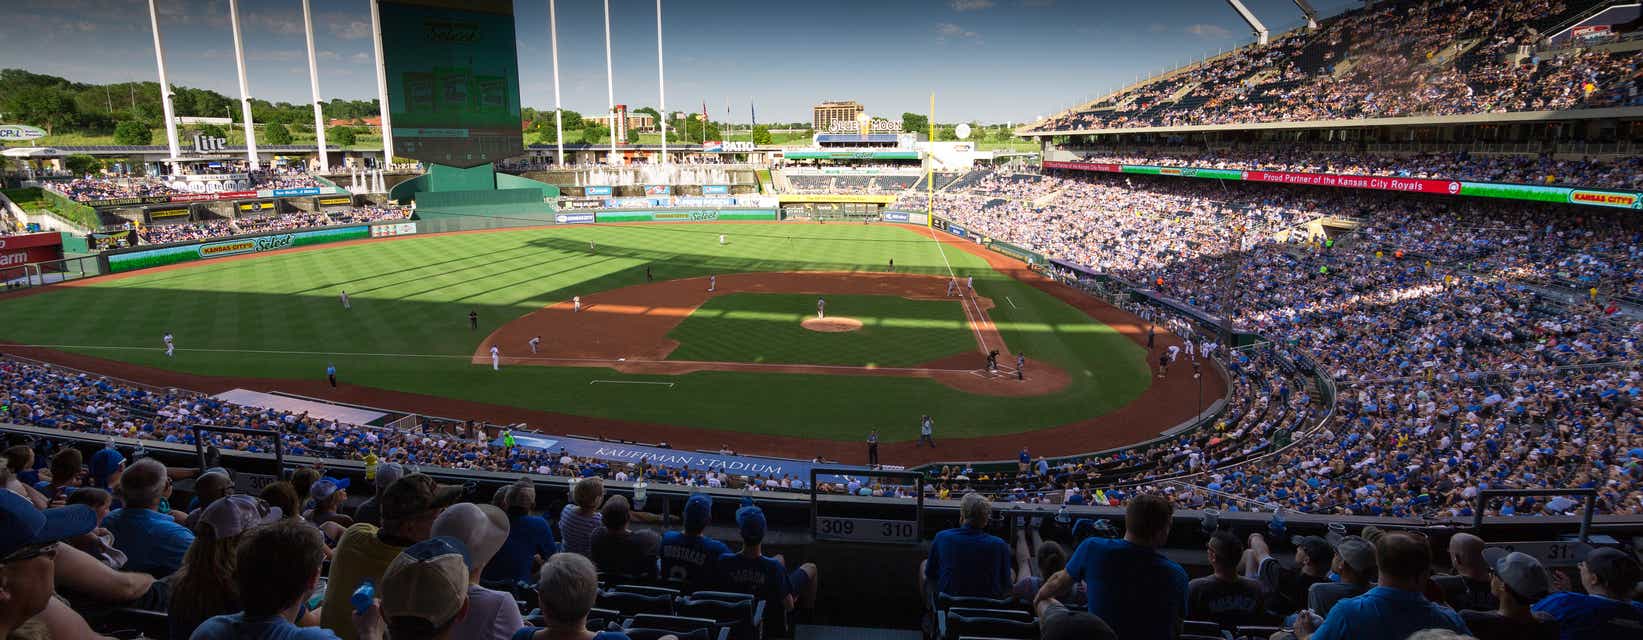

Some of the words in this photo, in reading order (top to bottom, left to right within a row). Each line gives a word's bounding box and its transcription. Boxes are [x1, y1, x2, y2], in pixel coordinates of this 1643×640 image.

[829, 119, 859, 132] BLUE
[870, 120, 903, 131] MOON
[192, 134, 226, 154] Lite
[722, 141, 755, 152] PATIO
[1263, 173, 1283, 182] Proud
[1285, 174, 1312, 184] Partner
[1313, 175, 1323, 184] of
[1323, 176, 1335, 185] the
[1338, 177, 1368, 187] Kansas
[1370, 178, 1388, 190] City
[1391, 179, 1424, 191] Royals
[204, 245, 232, 255] KANSAS
[256, 234, 292, 252] Select
[0, 251, 28, 265] arm
[594, 447, 695, 465] KAUFFMAN
[698, 457, 784, 475] STADIUM
[822, 519, 855, 535] 309
[881, 521, 914, 537] 310
[1549, 544, 1576, 559] 31
